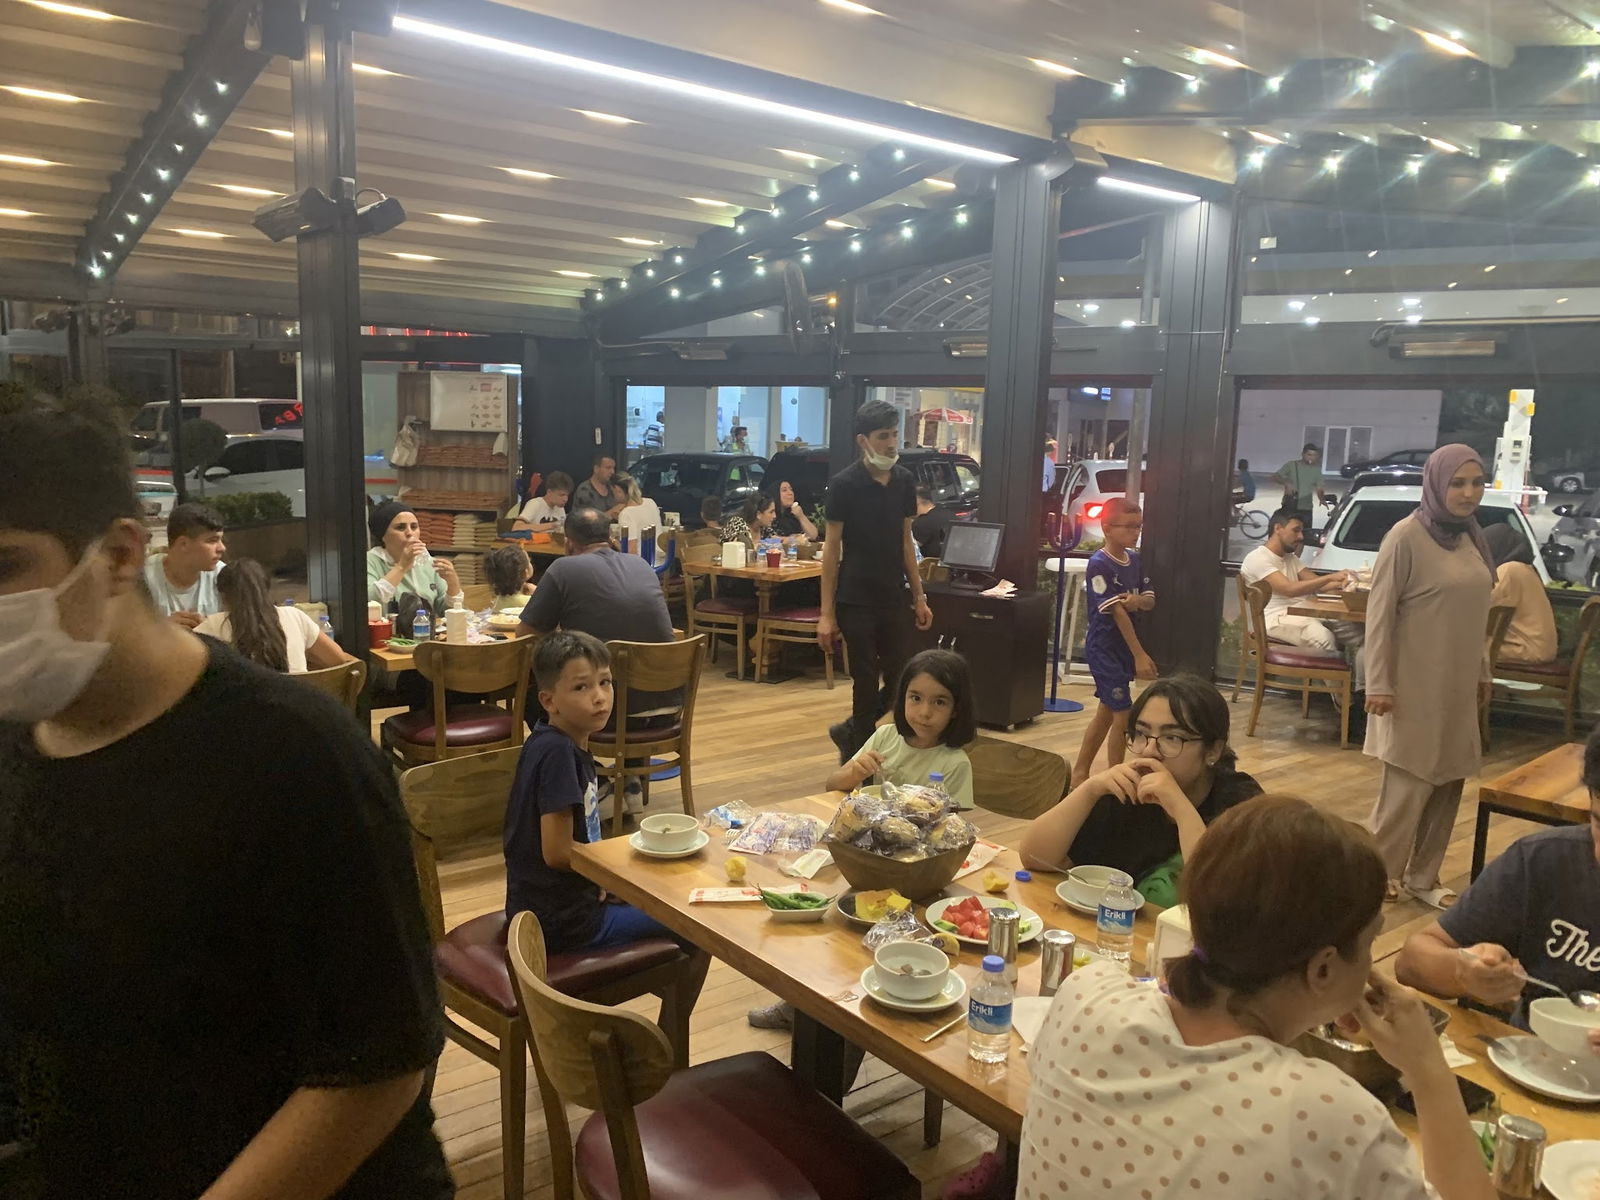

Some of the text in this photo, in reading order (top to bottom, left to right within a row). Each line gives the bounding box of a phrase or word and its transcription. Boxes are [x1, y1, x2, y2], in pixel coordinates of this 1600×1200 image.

[1104, 908, 1126, 920] Erikli
[1546, 919, 1600, 971] The
[971, 1000, 993, 1016] Erikli
